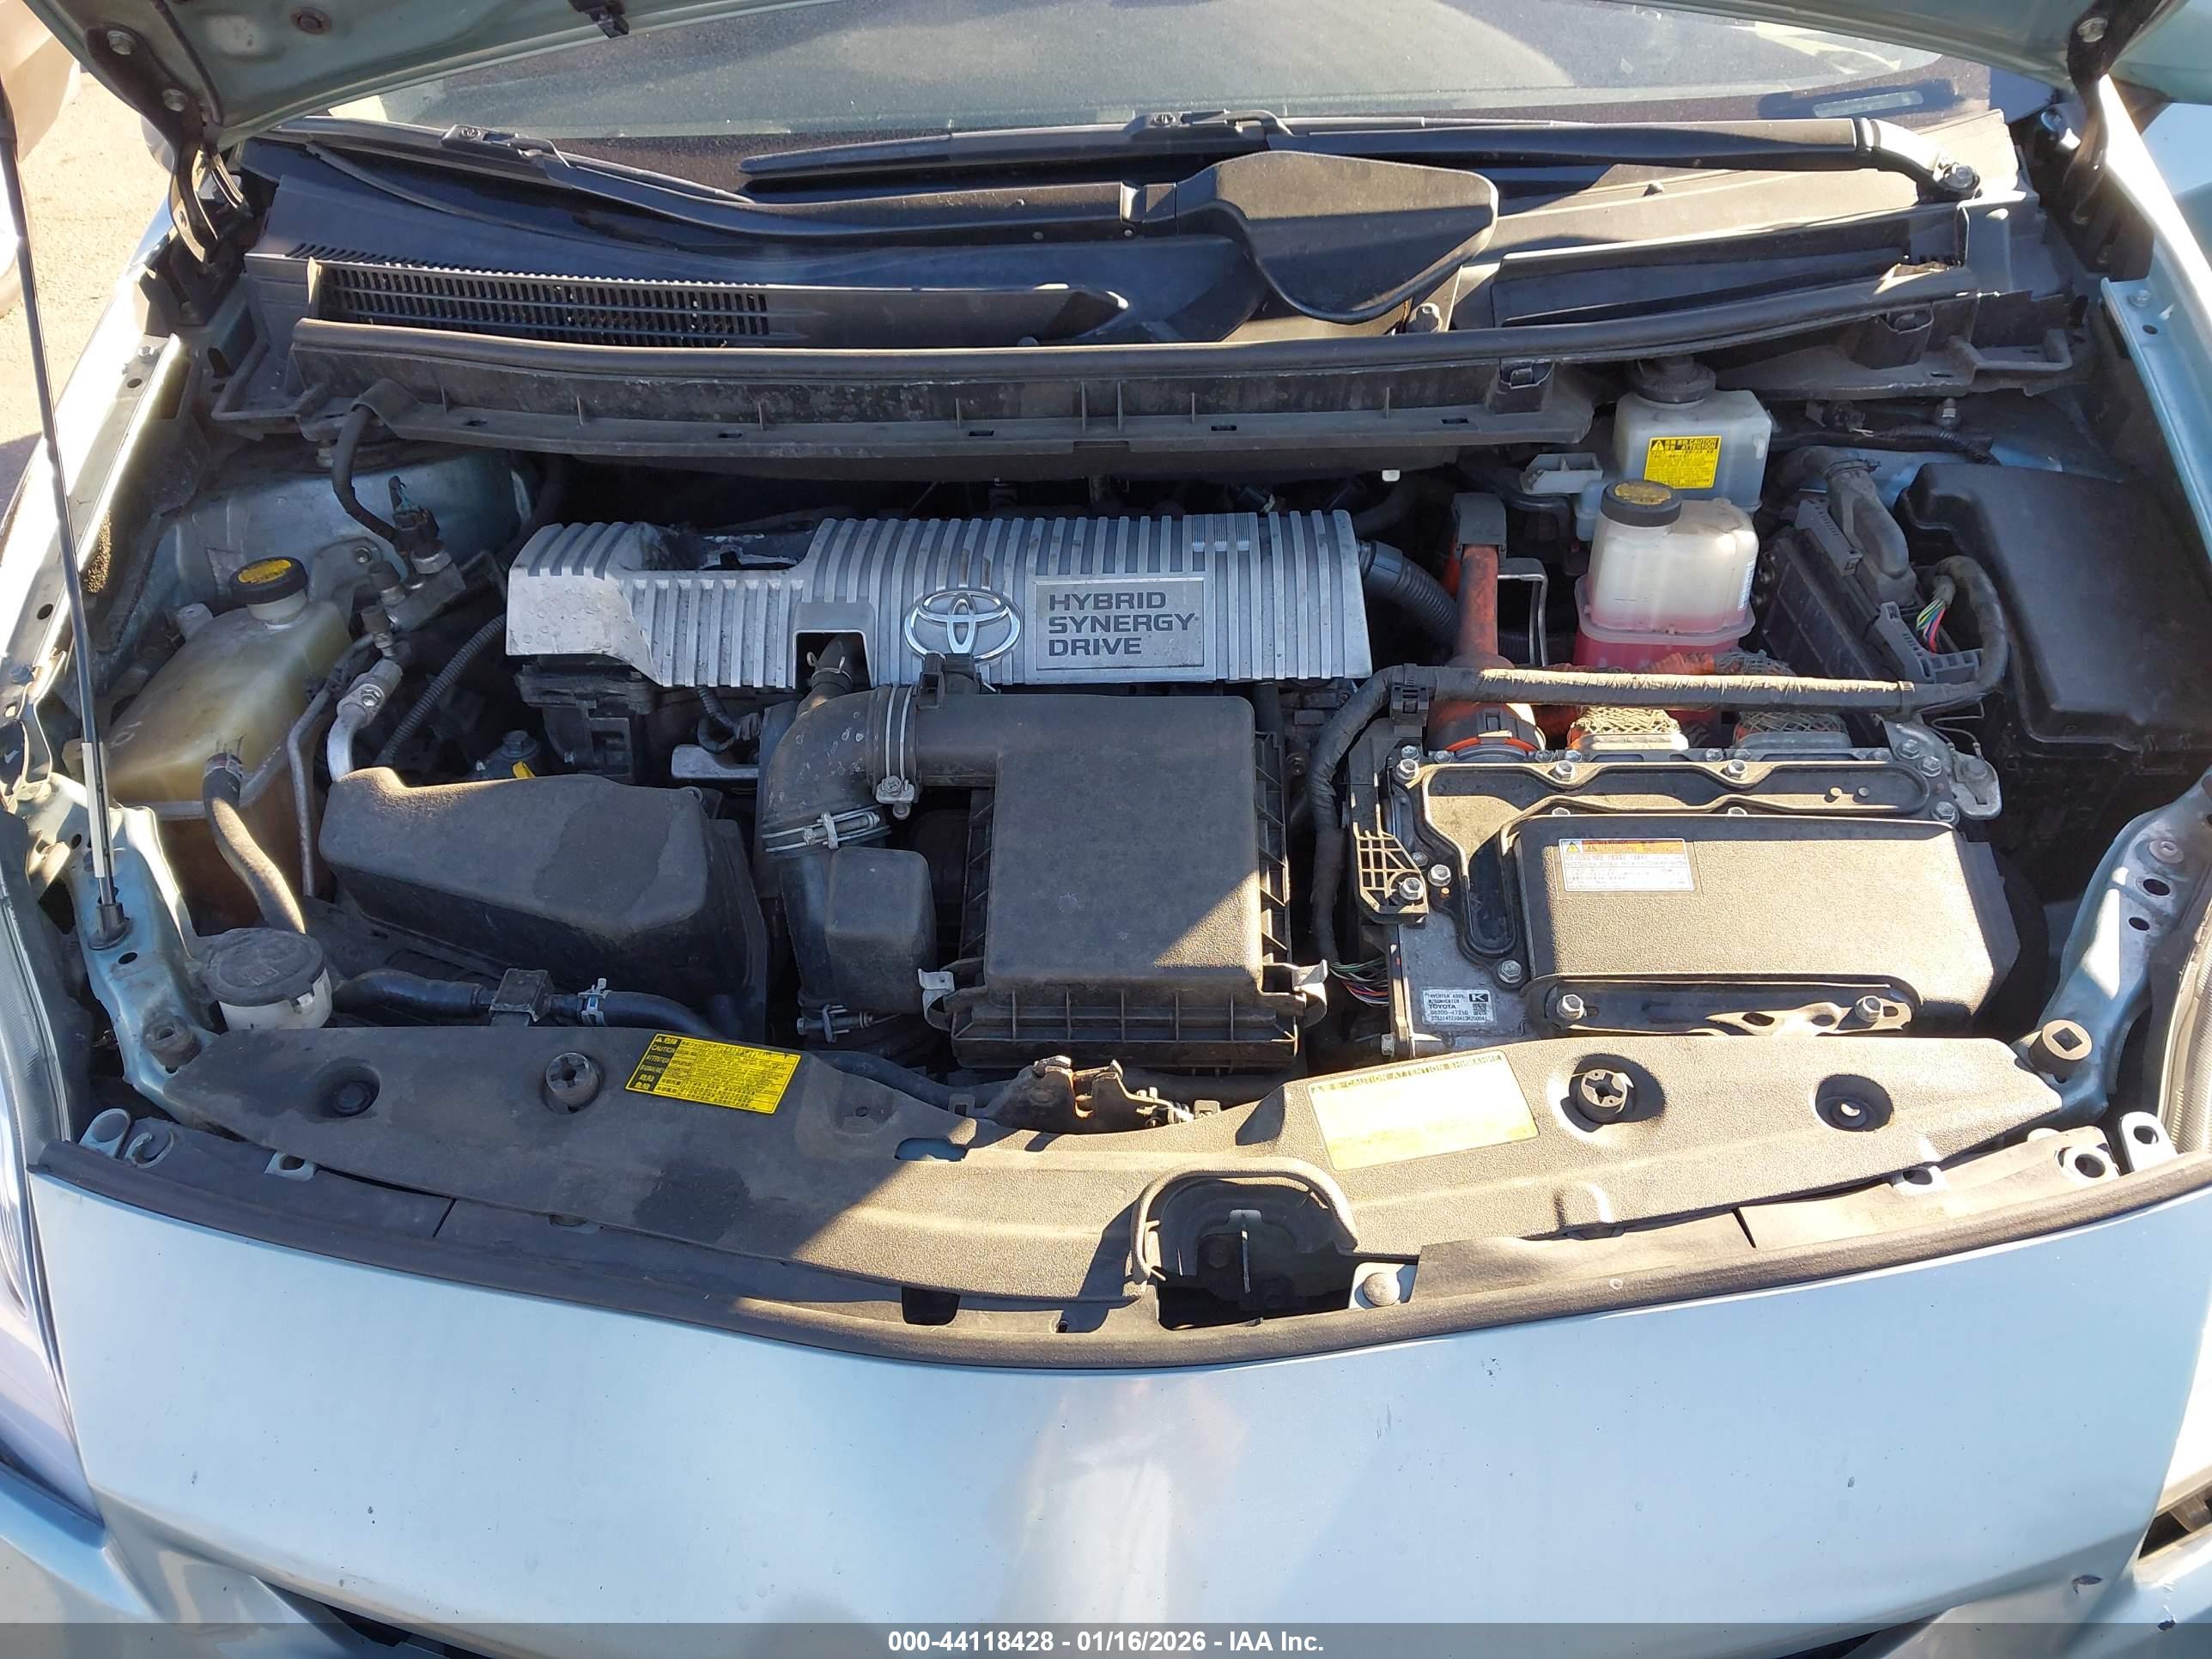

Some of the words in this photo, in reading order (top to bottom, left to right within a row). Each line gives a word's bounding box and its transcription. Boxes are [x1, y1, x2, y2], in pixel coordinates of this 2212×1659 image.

[1049, 592, 1167, 611] HYBRID
[1048, 613, 1196, 635] SYNERGY
[1048, 637, 1142, 657] DRIVE
[651, 1044, 676, 1054] CAUTION
[1346, 1073, 1387, 1088] CAUTION
[1393, 1064, 1443, 1080] ATTENTION
